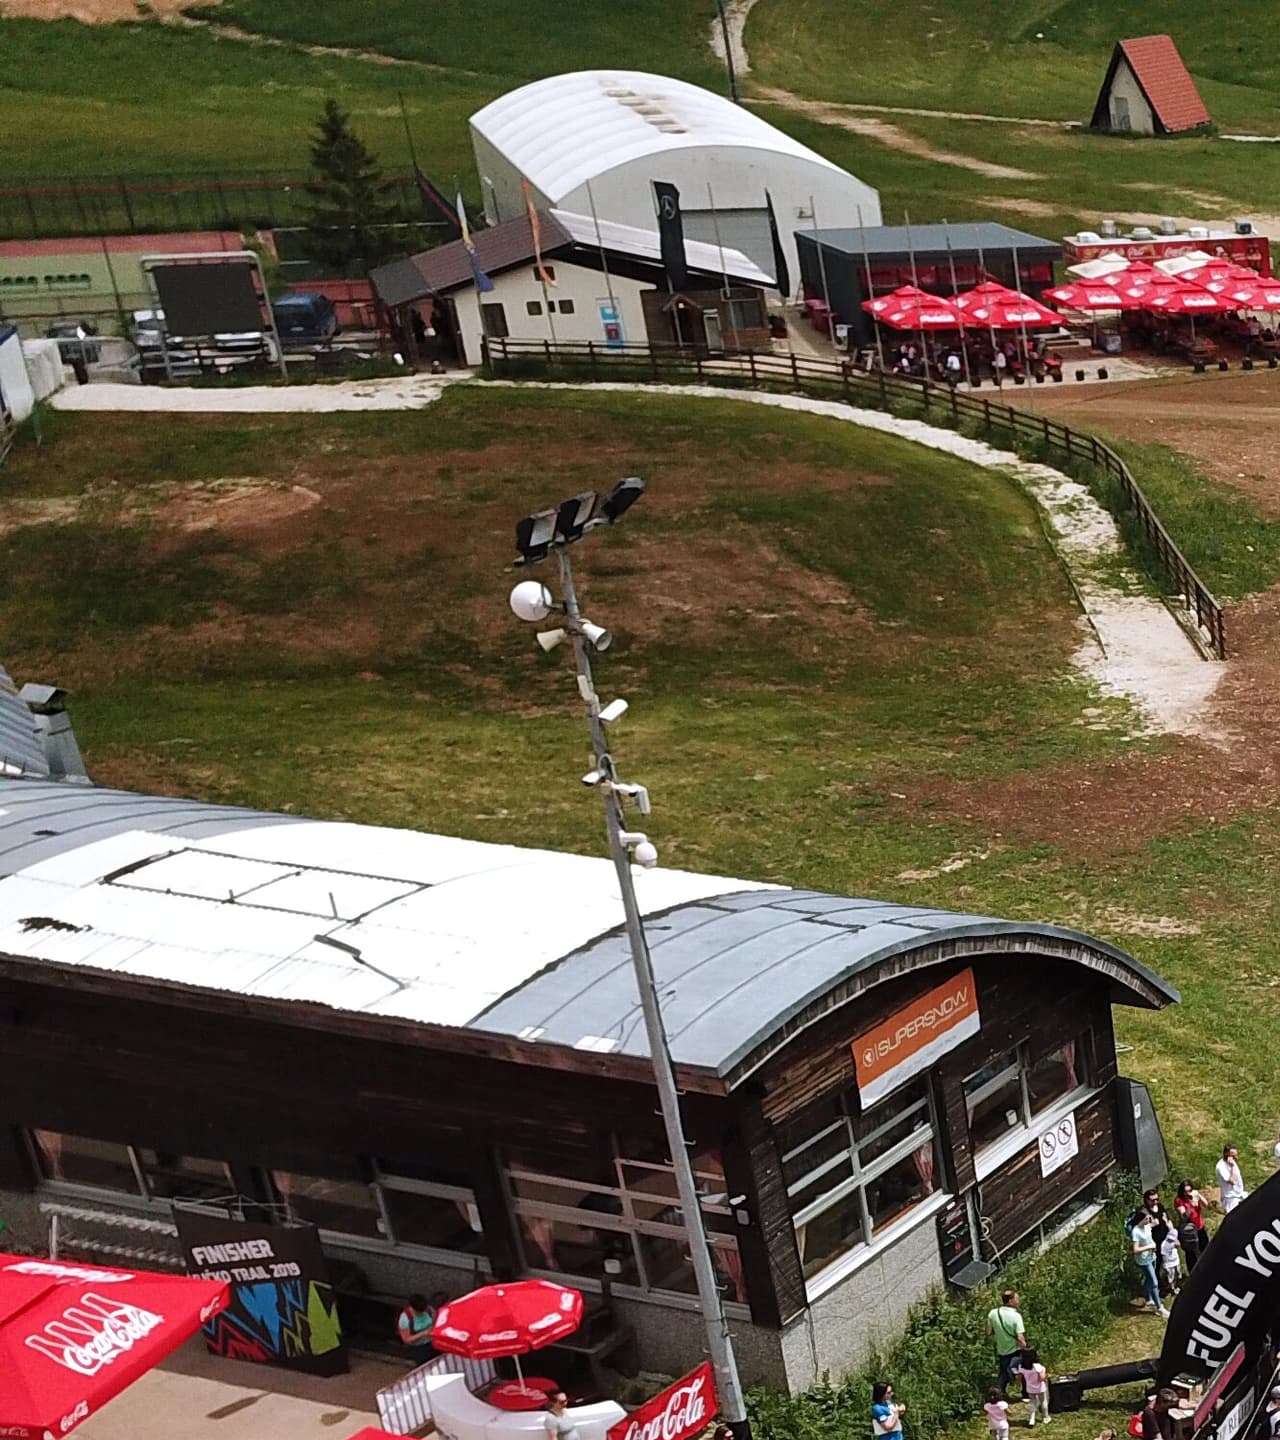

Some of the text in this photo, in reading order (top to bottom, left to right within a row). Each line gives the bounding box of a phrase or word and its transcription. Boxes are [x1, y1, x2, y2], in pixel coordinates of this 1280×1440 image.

[877, 987, 969, 1057] SUPERSNOW
[191, 1238, 275, 1266] FINISHER
[230, 1265, 271, 1281] TRAIL
[269, 1261, 301, 1279] 2019
[1185, 1283, 1256, 1369] FUEL
